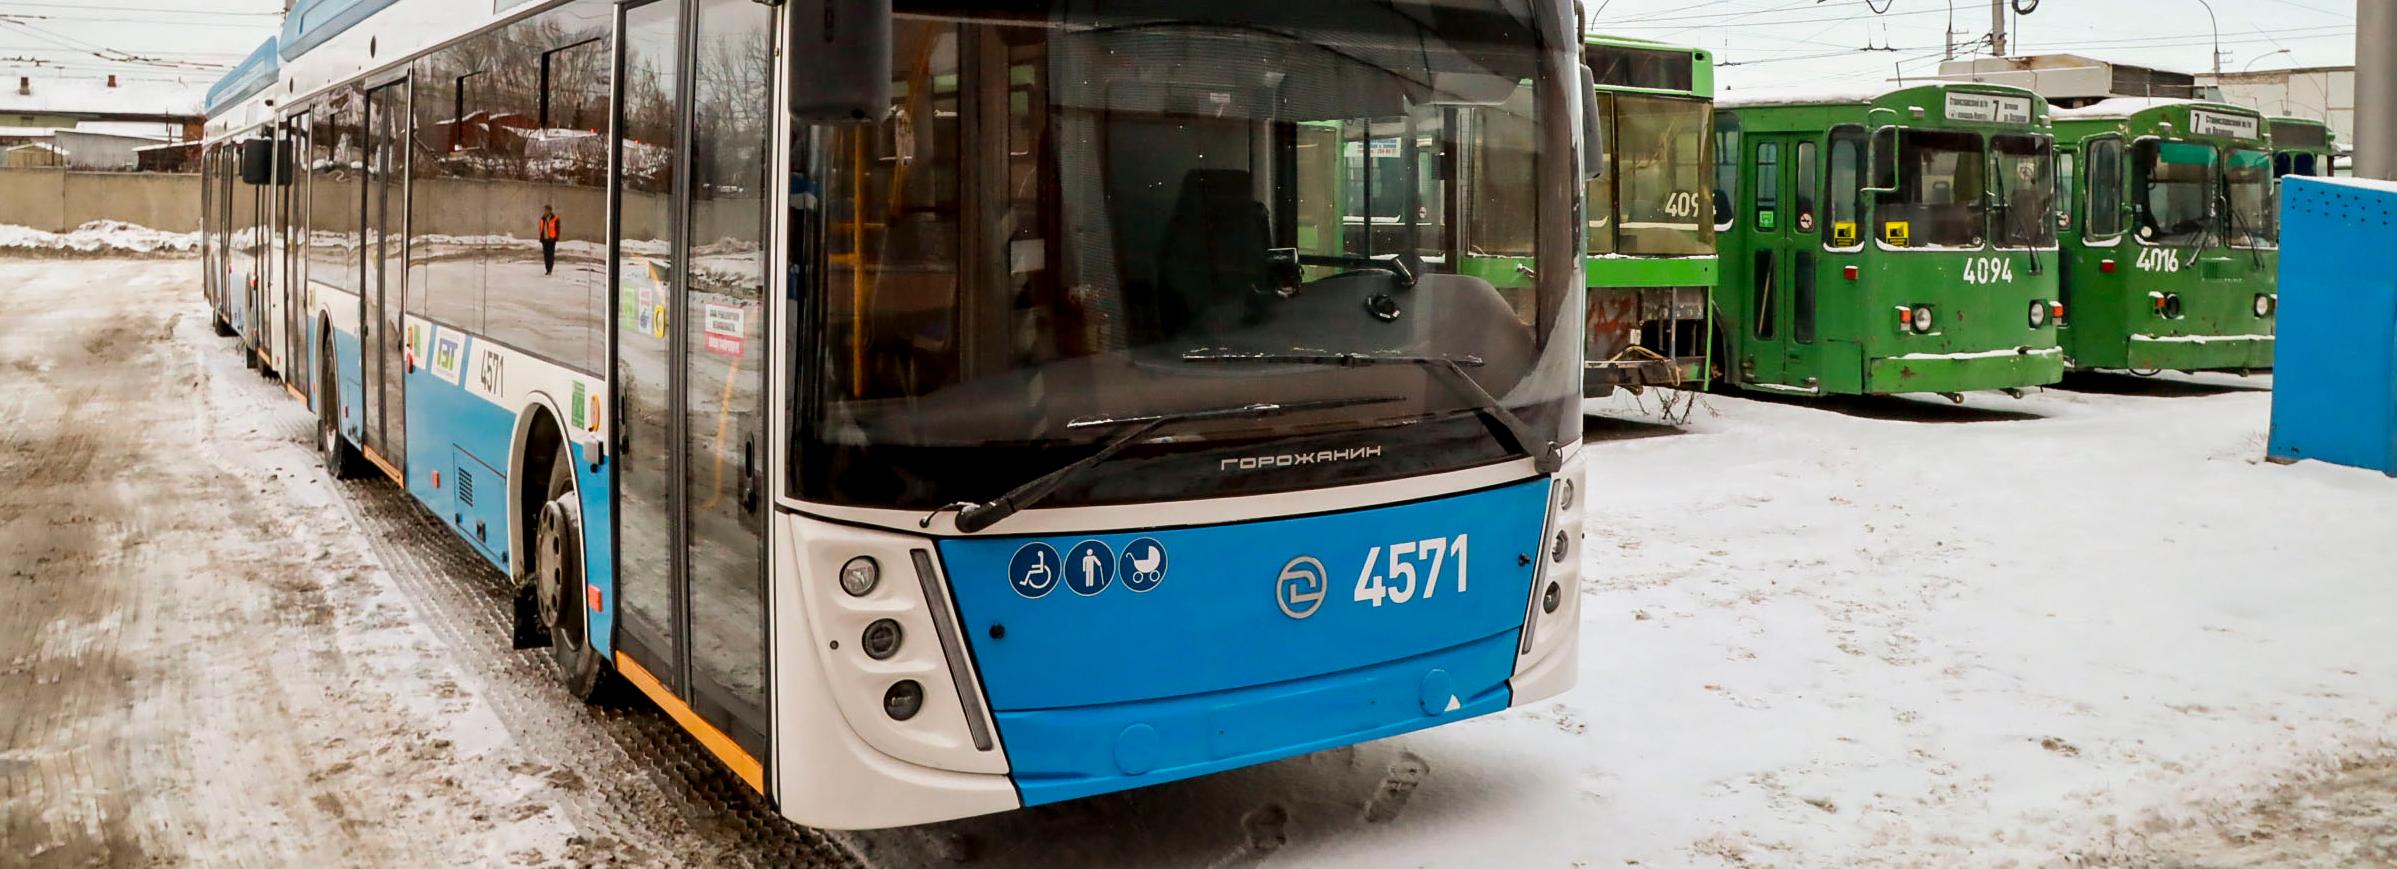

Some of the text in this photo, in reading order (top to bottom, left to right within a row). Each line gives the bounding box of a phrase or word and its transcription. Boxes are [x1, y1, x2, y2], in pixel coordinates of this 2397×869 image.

[1993, 100, 2000, 121] 7
[2194, 113, 2200, 133] 7
[1664, 191, 1717, 218] 409
[1963, 257, 2013, 285] 4094
[2136, 247, 2179, 273] 4016
[481, 348, 504, 399] 4571
[1221, 445, 1382, 471] ГОРОЖАНИН
[1354, 533, 1468, 608] 4571
